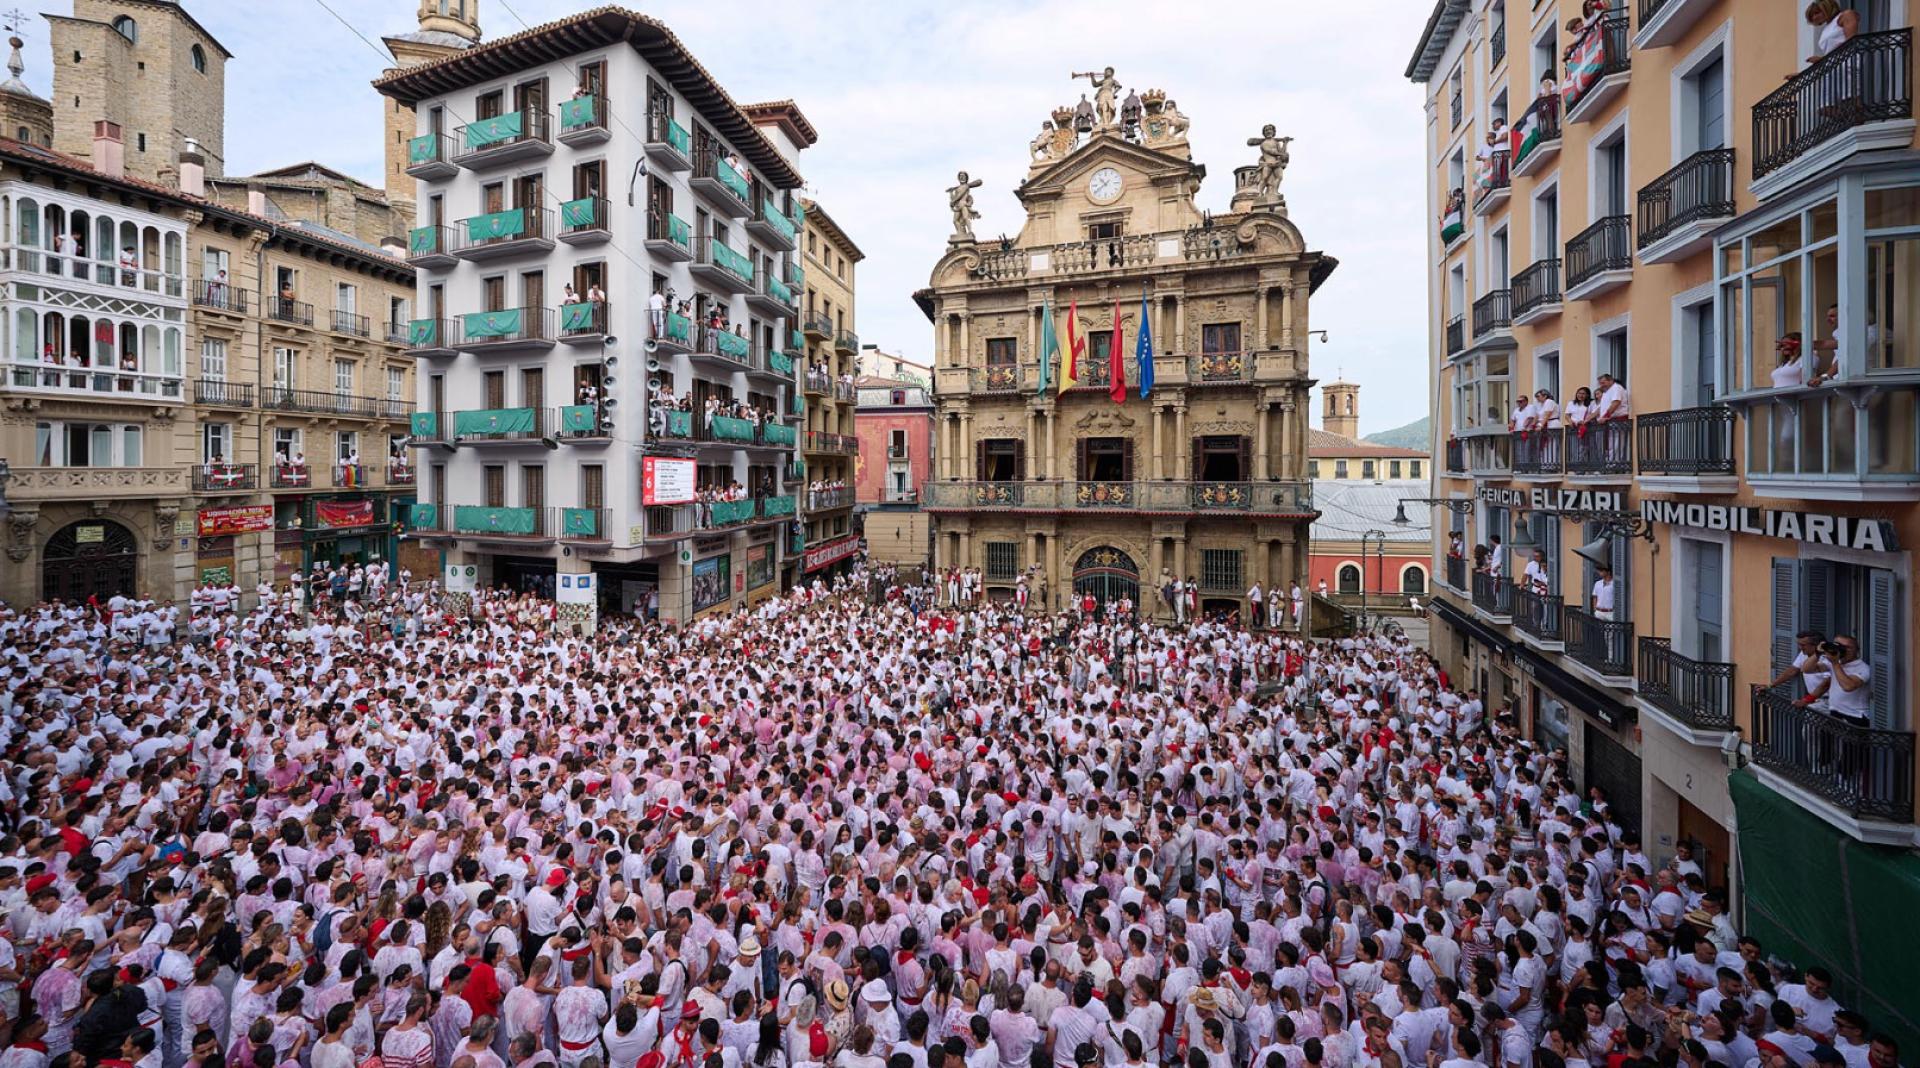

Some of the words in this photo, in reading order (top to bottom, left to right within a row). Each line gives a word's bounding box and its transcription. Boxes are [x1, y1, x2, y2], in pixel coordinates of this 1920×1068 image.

[646, 476, 652, 489] 6
[1478, 487, 1522, 507] GENCIA
[1531, 488, 1621, 512] ELIZARI
[1640, 500, 1886, 553] INMOBILIARIA
[1686, 773, 1692, 790] 2
